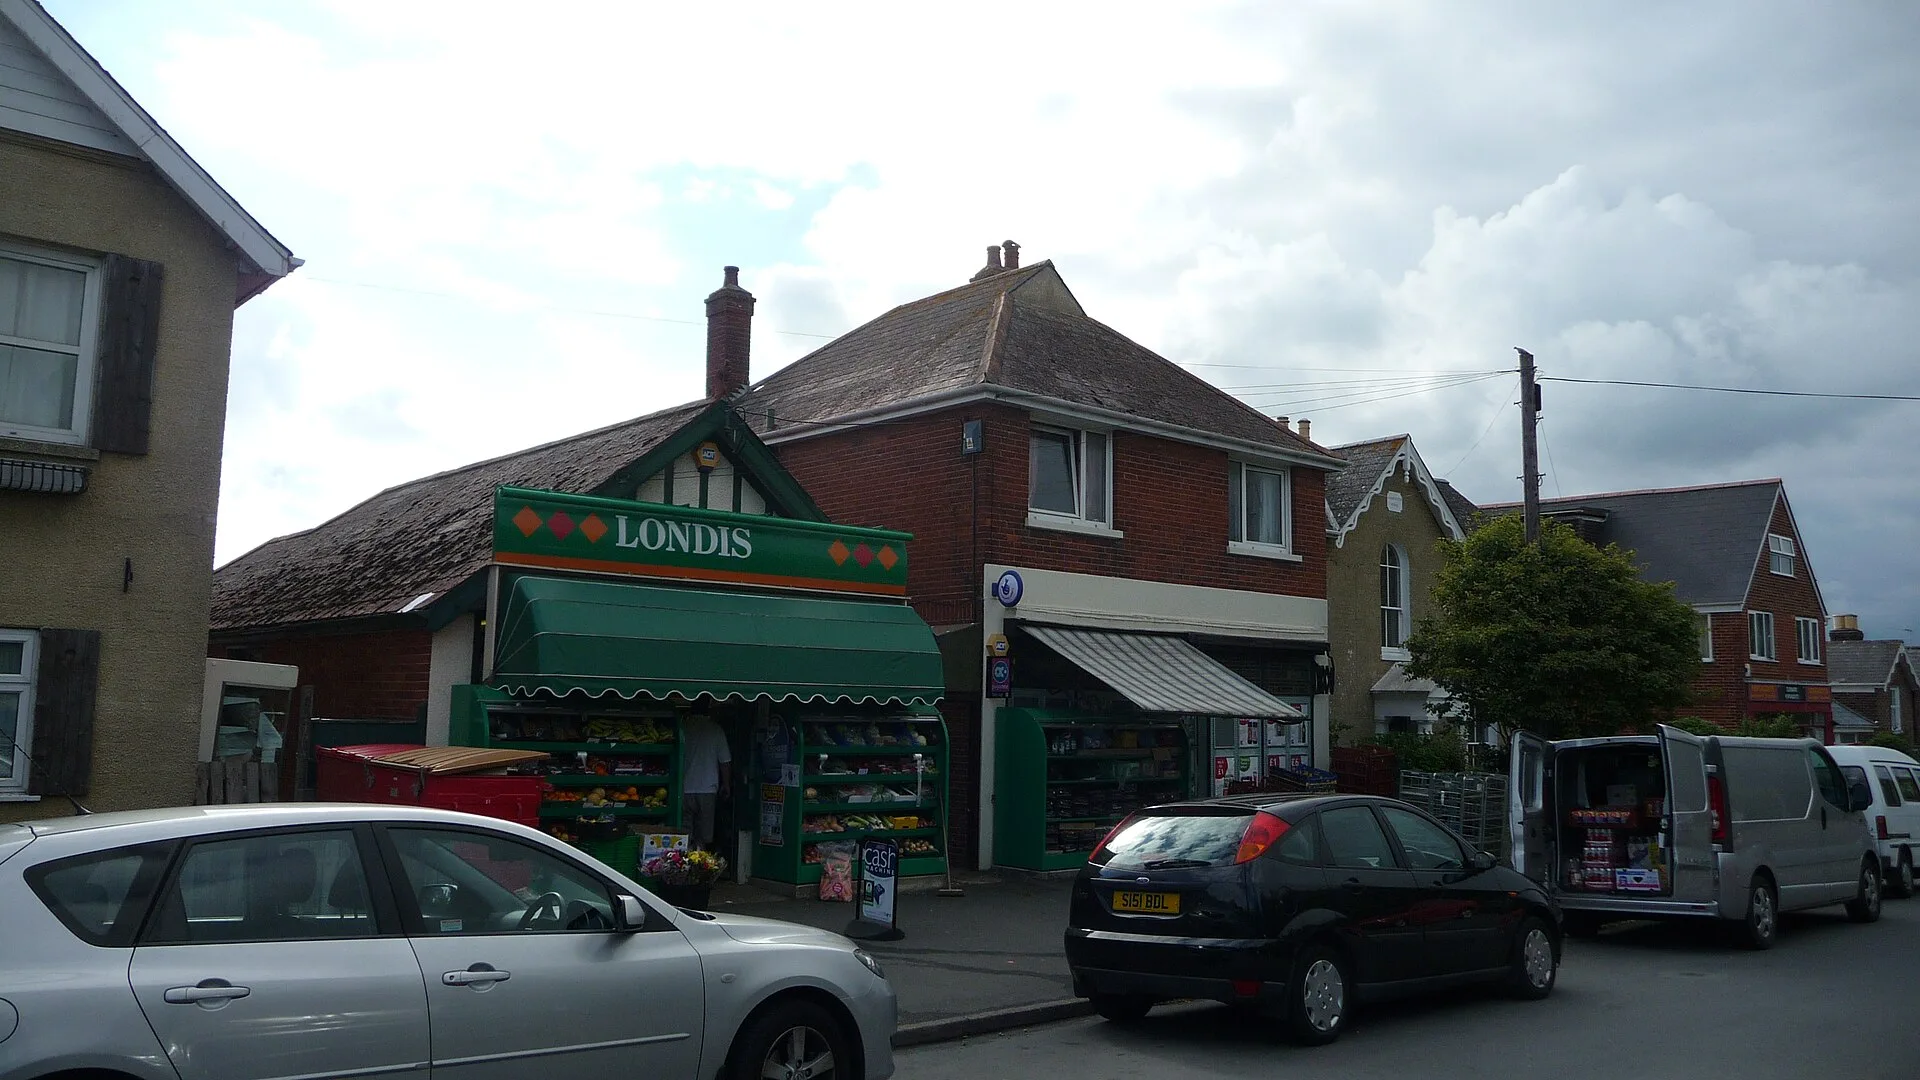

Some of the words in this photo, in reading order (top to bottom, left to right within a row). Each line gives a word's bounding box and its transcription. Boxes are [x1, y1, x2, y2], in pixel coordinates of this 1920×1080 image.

[615, 515, 752, 559] LONDIS
[866, 865, 895, 876] MACHINE
[1122, 893, 1142, 907] S151
[1146, 895, 1169, 909] BDL
